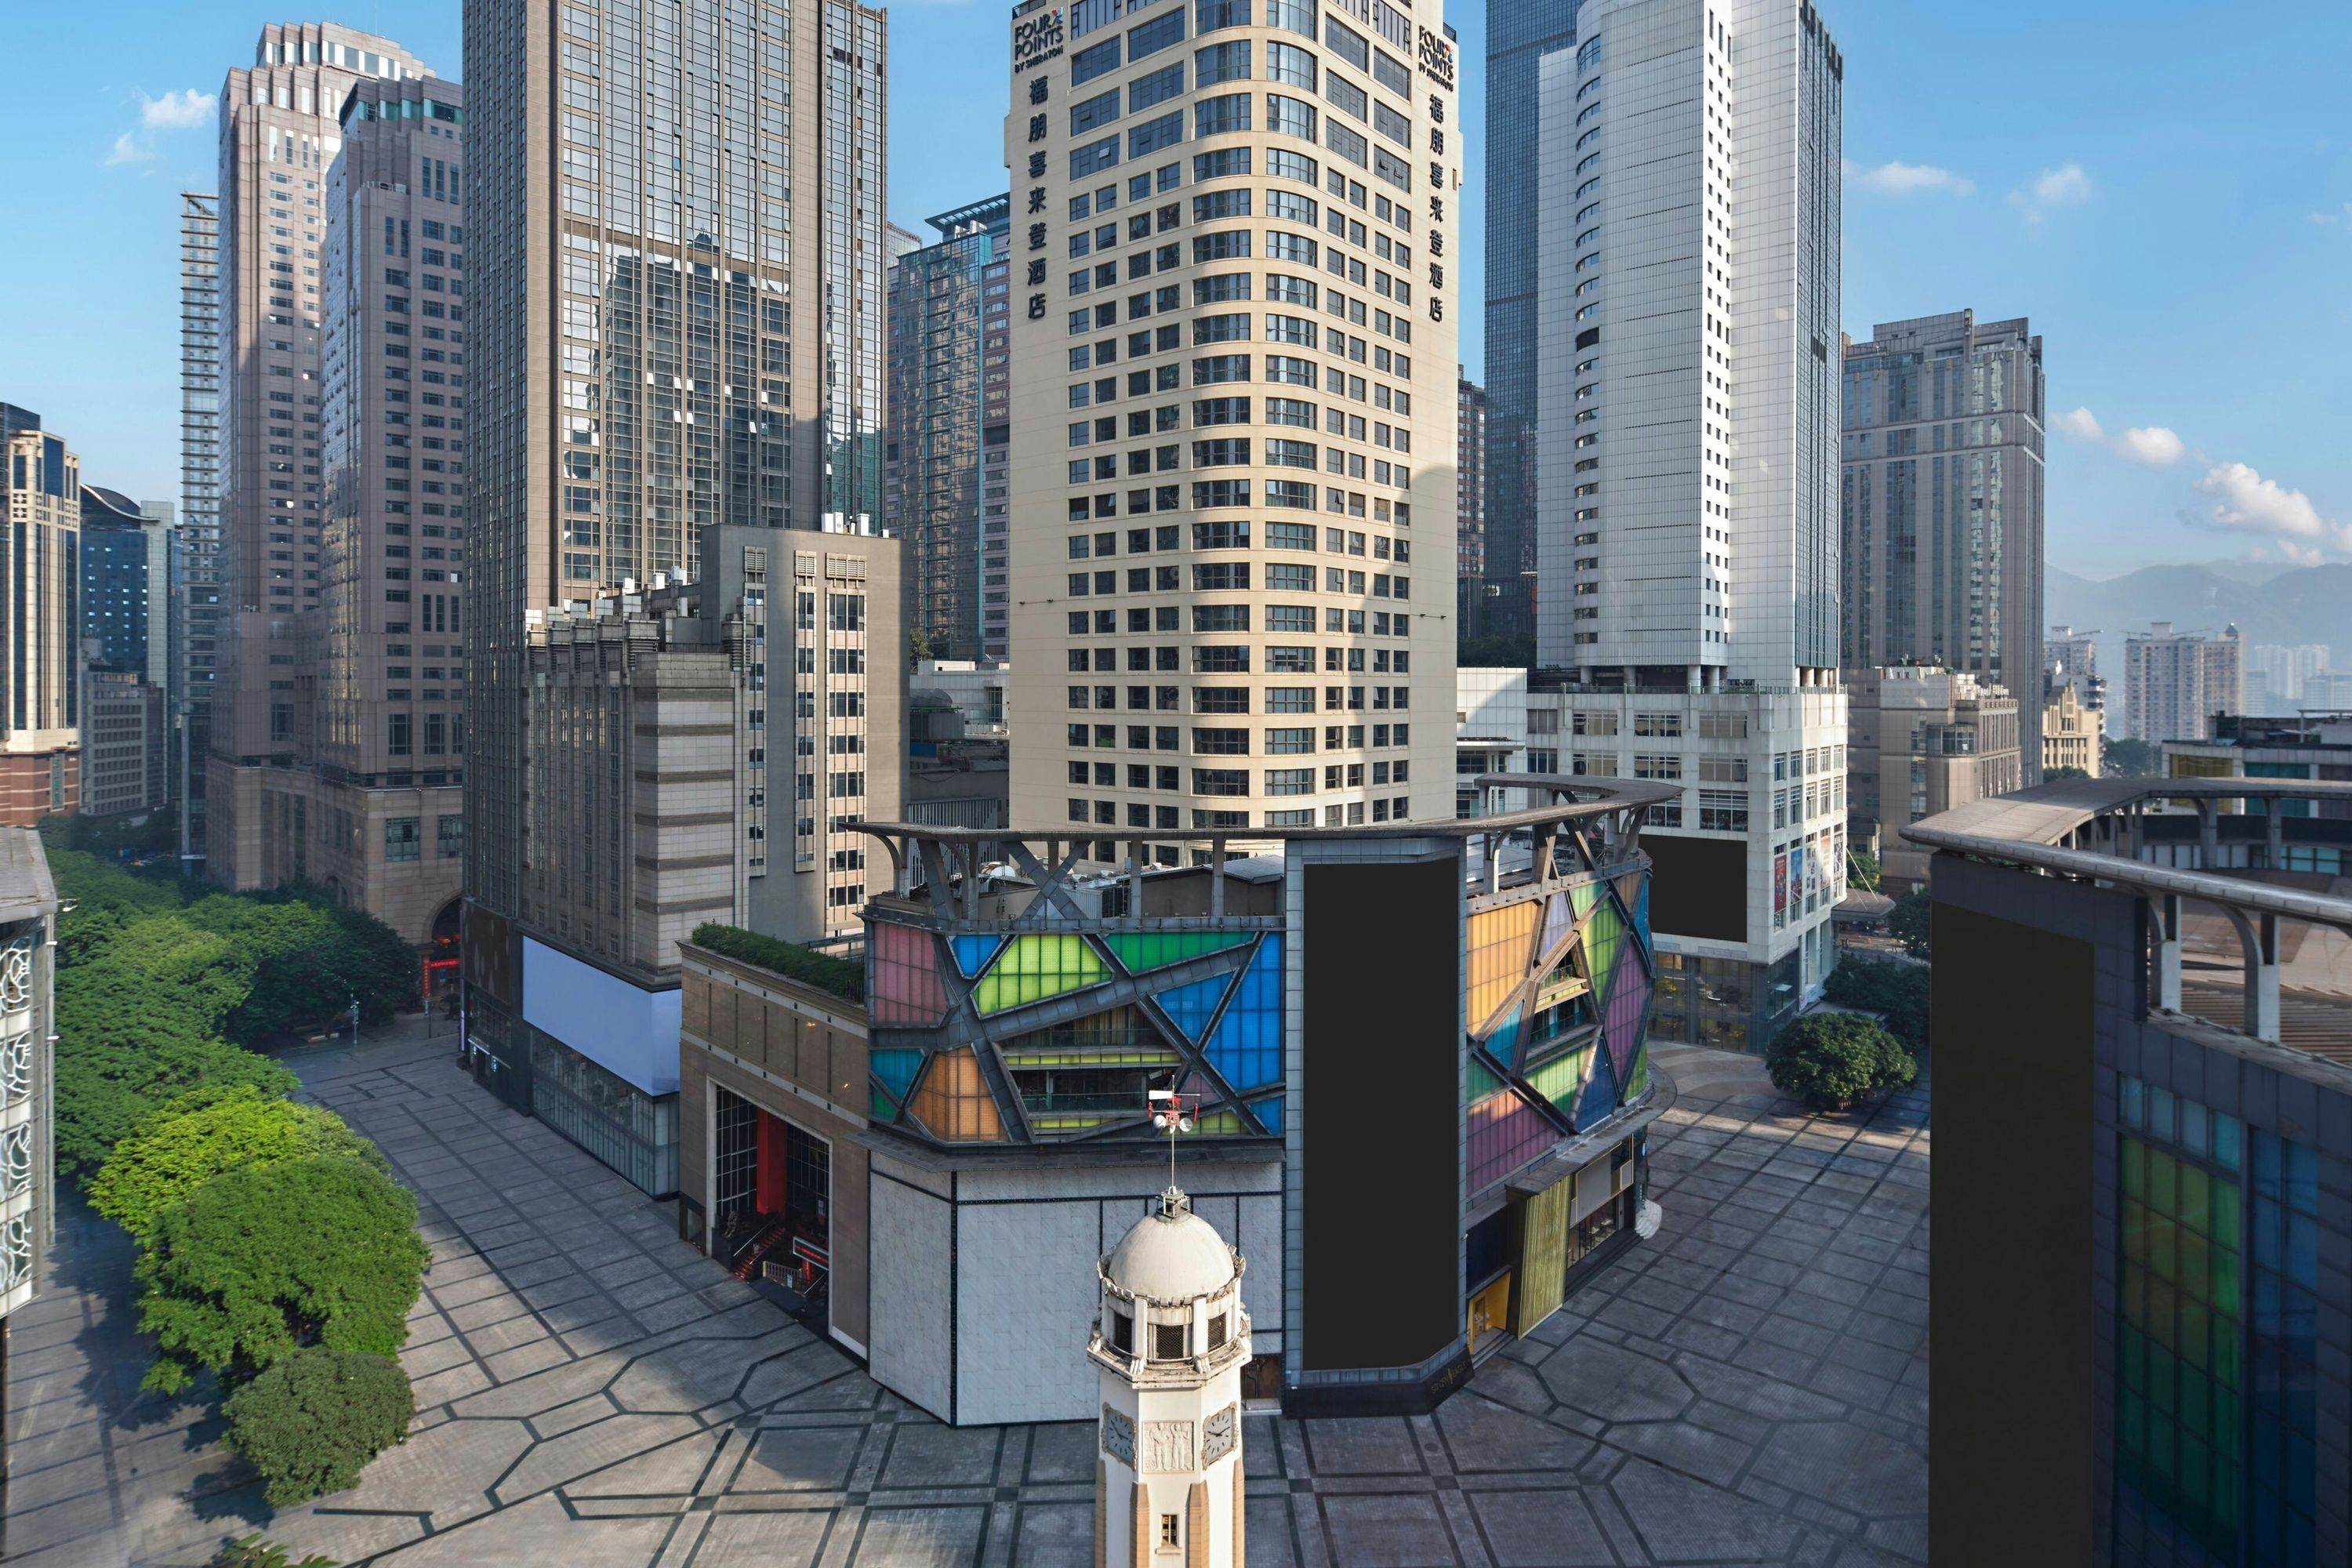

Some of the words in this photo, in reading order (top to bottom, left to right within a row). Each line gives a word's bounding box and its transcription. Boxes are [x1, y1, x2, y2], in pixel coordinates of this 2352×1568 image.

[1014, 13, 1051, 43] FOUR
[1014, 26, 1064, 61] POINTS
[1418, 25, 1445, 56] FOUR
[1014, 62, 1025, 73] BY
[1026, 45, 1064, 69] SHERATON
[1418, 42, 1454, 81] POINTS
[1028, 75, 1048, 320] 福朋喜来登酒店
[1429, 93, 1443, 322] 福朋喜来登酒店
